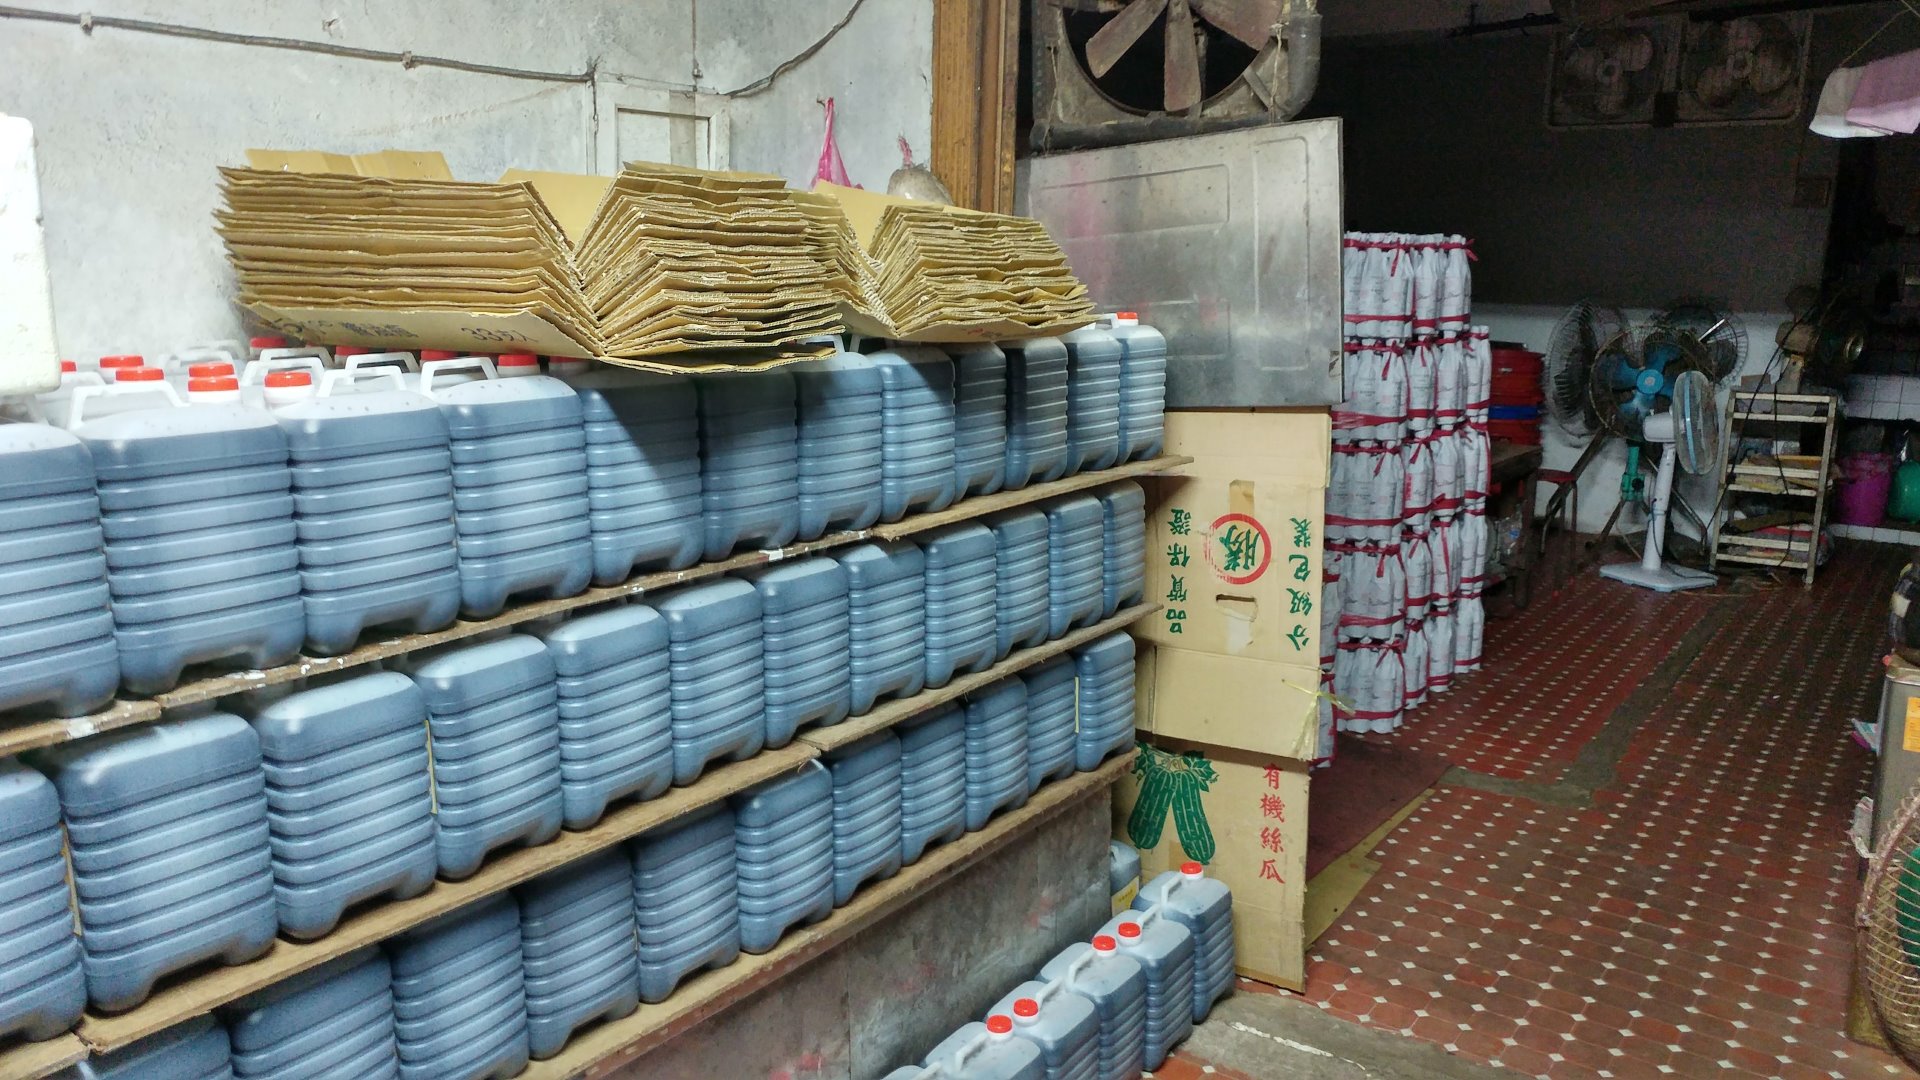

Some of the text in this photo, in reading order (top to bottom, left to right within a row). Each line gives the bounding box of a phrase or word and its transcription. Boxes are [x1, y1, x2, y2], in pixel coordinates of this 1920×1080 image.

[1165, 508, 1192, 635] 品質保證
[1218, 524, 1261, 572] 勝
[1285, 516, 1314, 652] 分級包裝
[1260, 763, 1285, 884] 有機絲瓜
